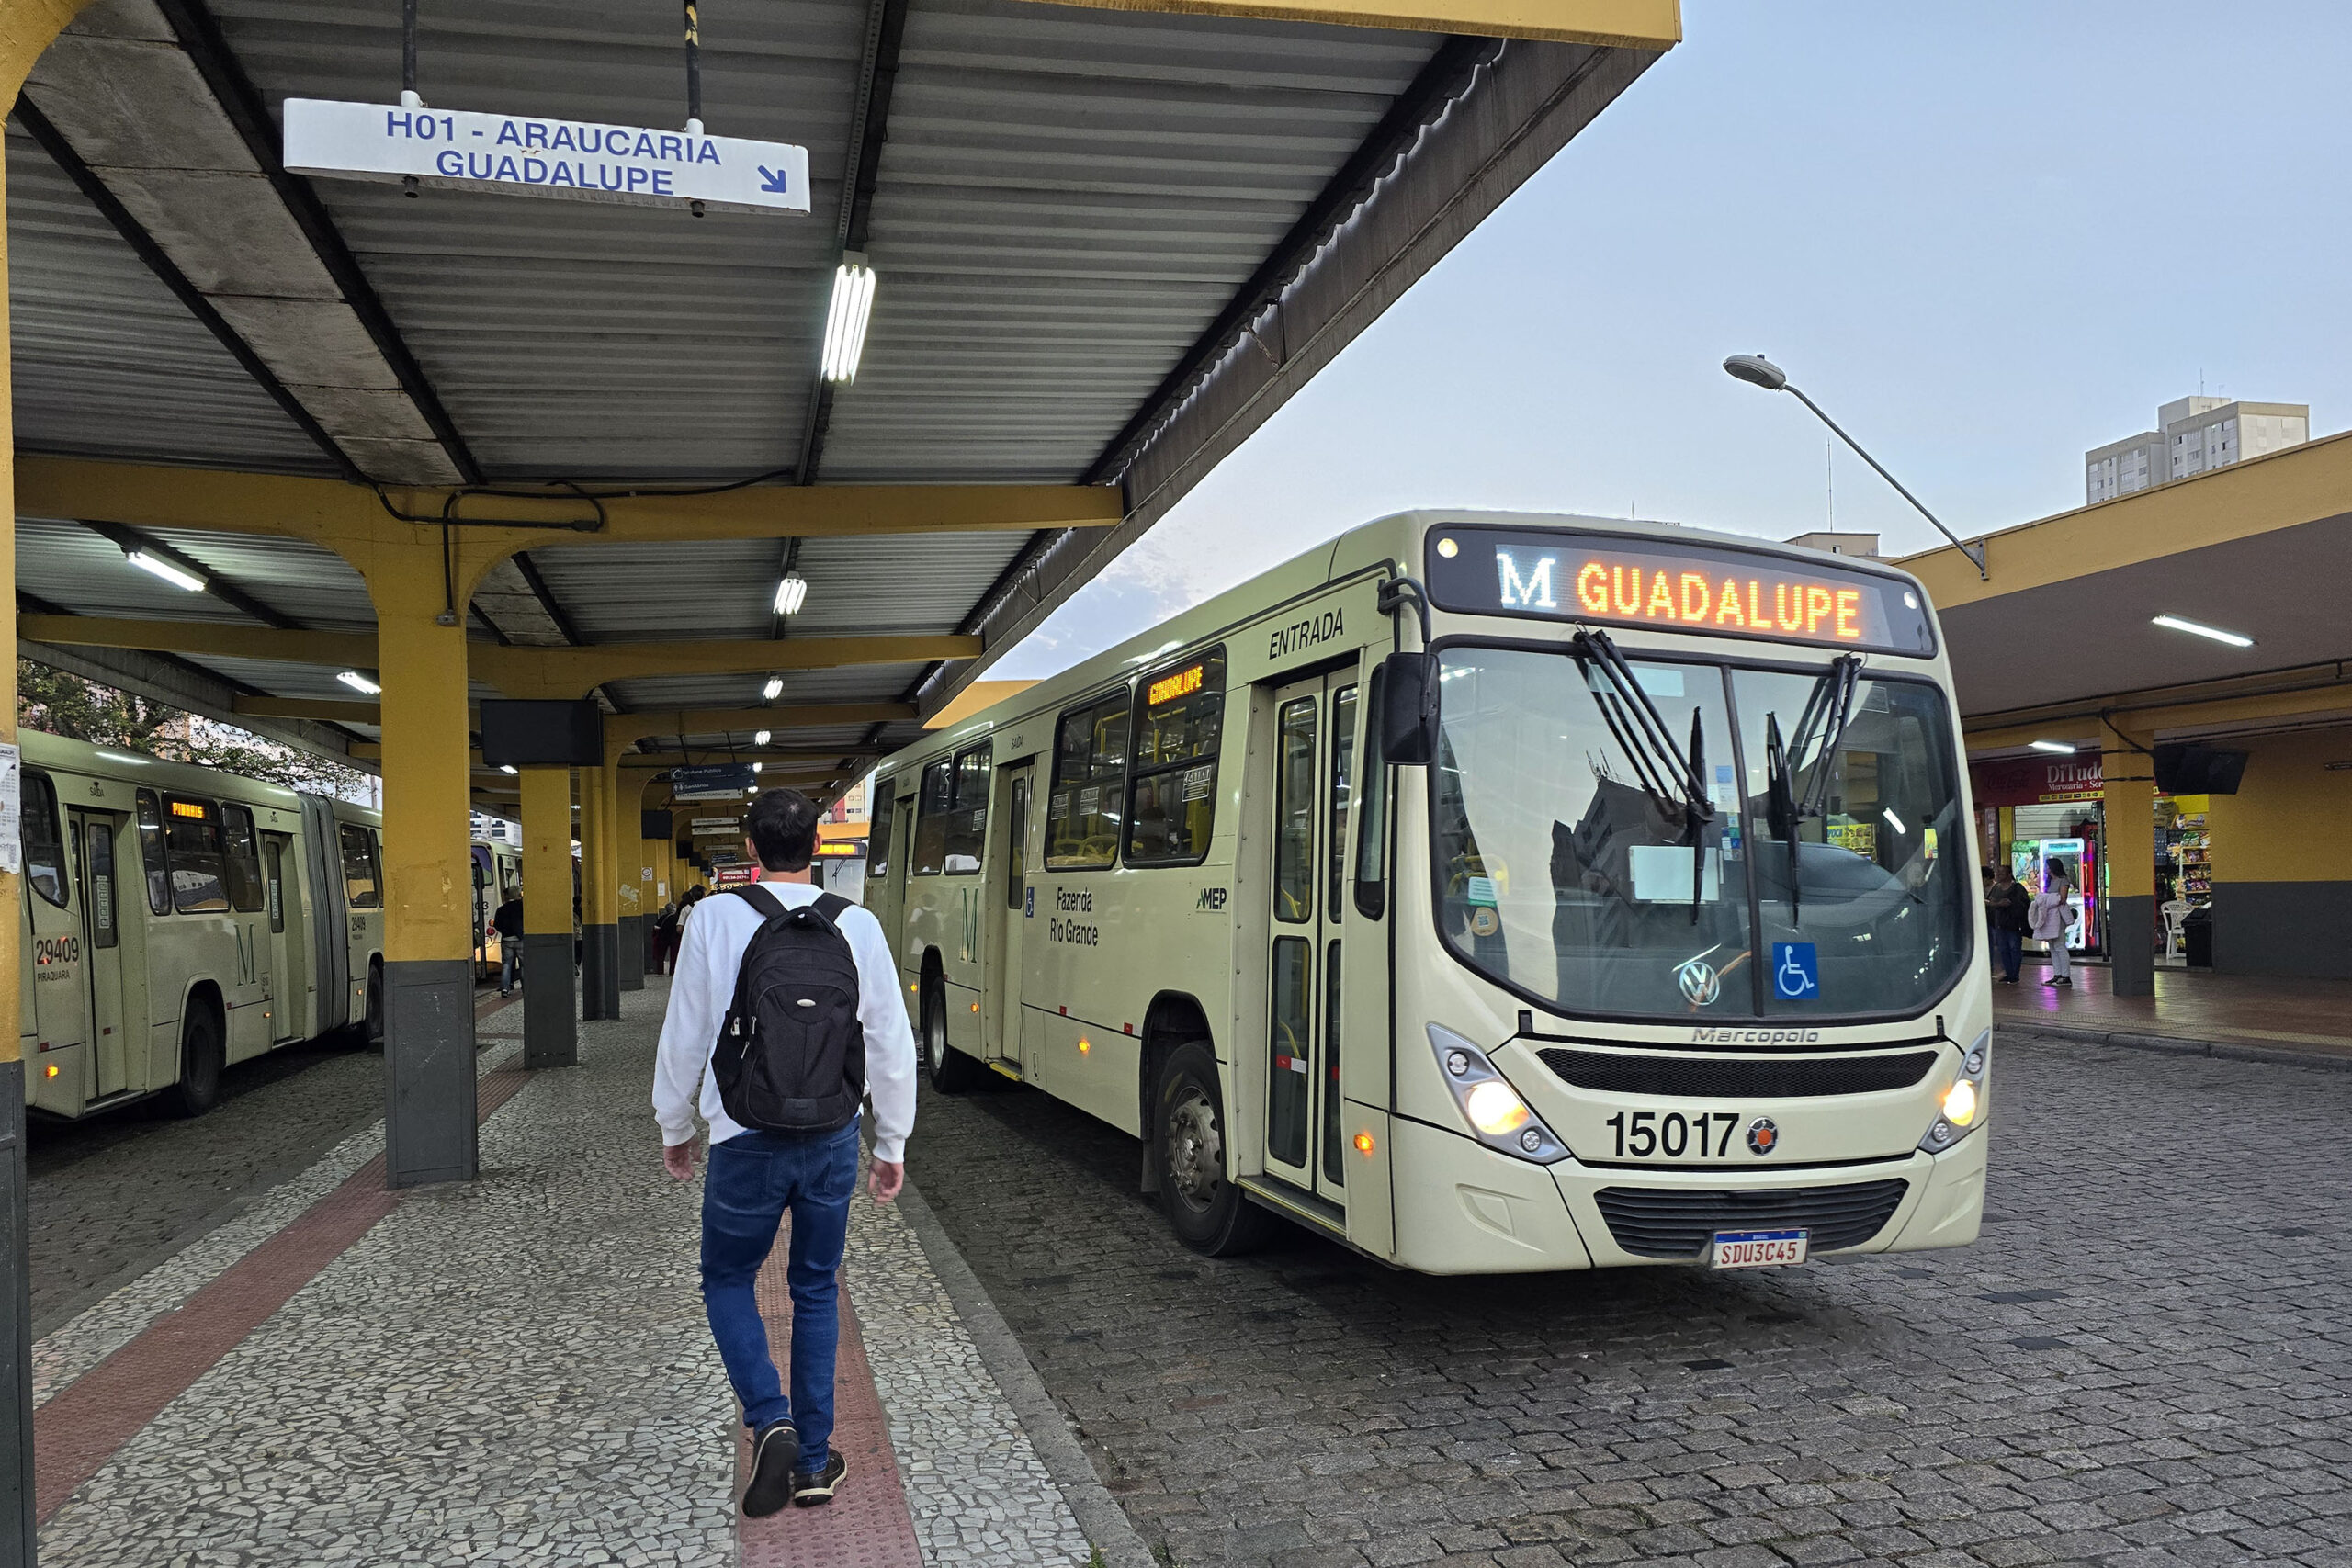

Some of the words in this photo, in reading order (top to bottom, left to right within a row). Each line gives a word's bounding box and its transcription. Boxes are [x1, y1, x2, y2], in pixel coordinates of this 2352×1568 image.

[387, 110, 454, 141] H01
[496, 118, 722, 165] ARAUCÁRIA
[436, 150, 674, 196] GUADALUPE
[1497, 553, 1557, 608] M
[1577, 562, 1860, 638] GUADALUPE
[1269, 607, 1344, 660] ENTRADA
[1148, 665, 1204, 705] GUADALUPE
[1057, 887, 1092, 913] Fazenda
[1196, 887, 1227, 910] AMEP
[960, 887, 979, 964] M
[1049, 918, 1064, 943] Rio
[1066, 918, 1099, 947] Grande
[36, 936, 80, 965] 29409
[233, 924, 258, 987] M
[37, 969, 71, 983] PIRAQUARA
[1691, 1027, 1819, 1045] Marcopolo
[1606, 1111, 1740, 1157] 15017
[1721, 1242, 1798, 1265] SDU3C45
